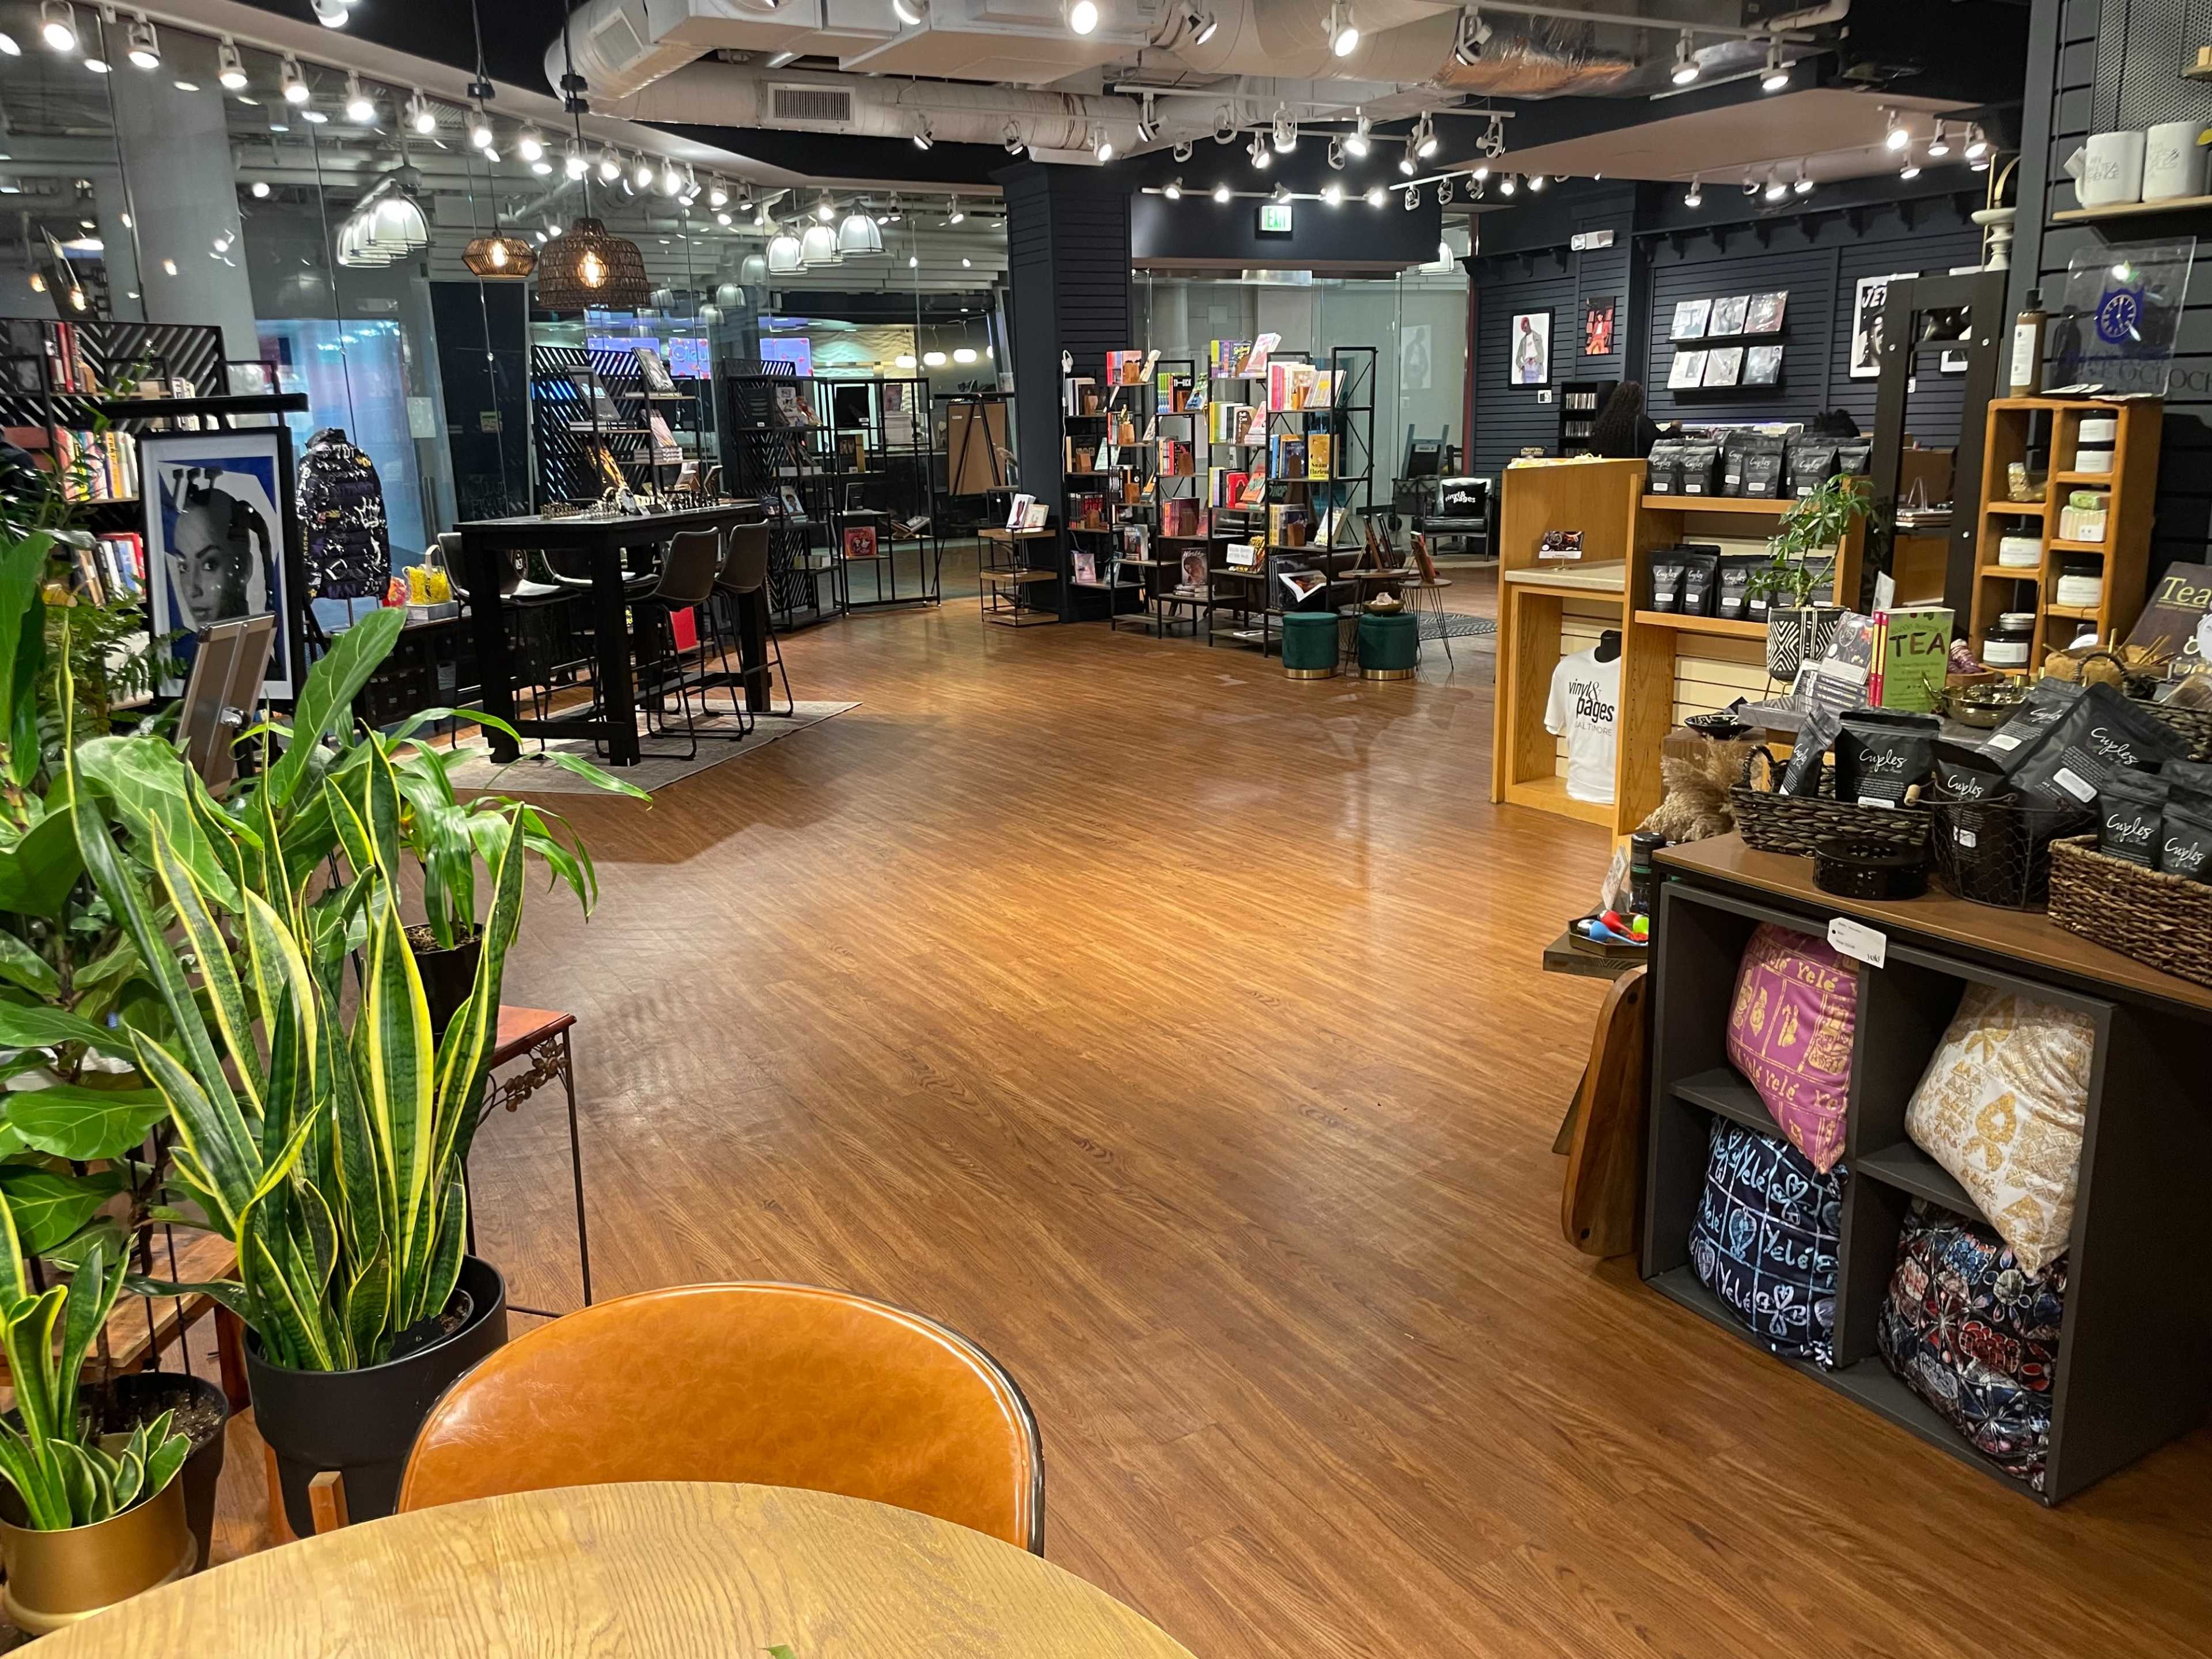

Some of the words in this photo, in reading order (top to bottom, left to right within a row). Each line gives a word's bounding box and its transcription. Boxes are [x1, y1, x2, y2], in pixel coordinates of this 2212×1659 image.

[1861, 286, 1888, 308] JET
[2161, 577, 2211, 605] Tea
[1889, 632, 1945, 657] TEA
[1576, 697, 1615, 723] pages
[1859, 749, 1908, 772] Cuples
[2091, 727, 2139, 765] Cuples
[1948, 775, 1984, 798] Cuples
[2107, 813, 2155, 843] Cuples
[2164, 837, 2206, 868] Cuples
[1797, 961, 1839, 993] Yelé
[1766, 1069, 1800, 1101] Yelé
[1735, 1149, 1771, 1194] Yelé
[1763, 1222, 1815, 1270] Yelé
[1720, 1262, 1752, 1314] Yelé
